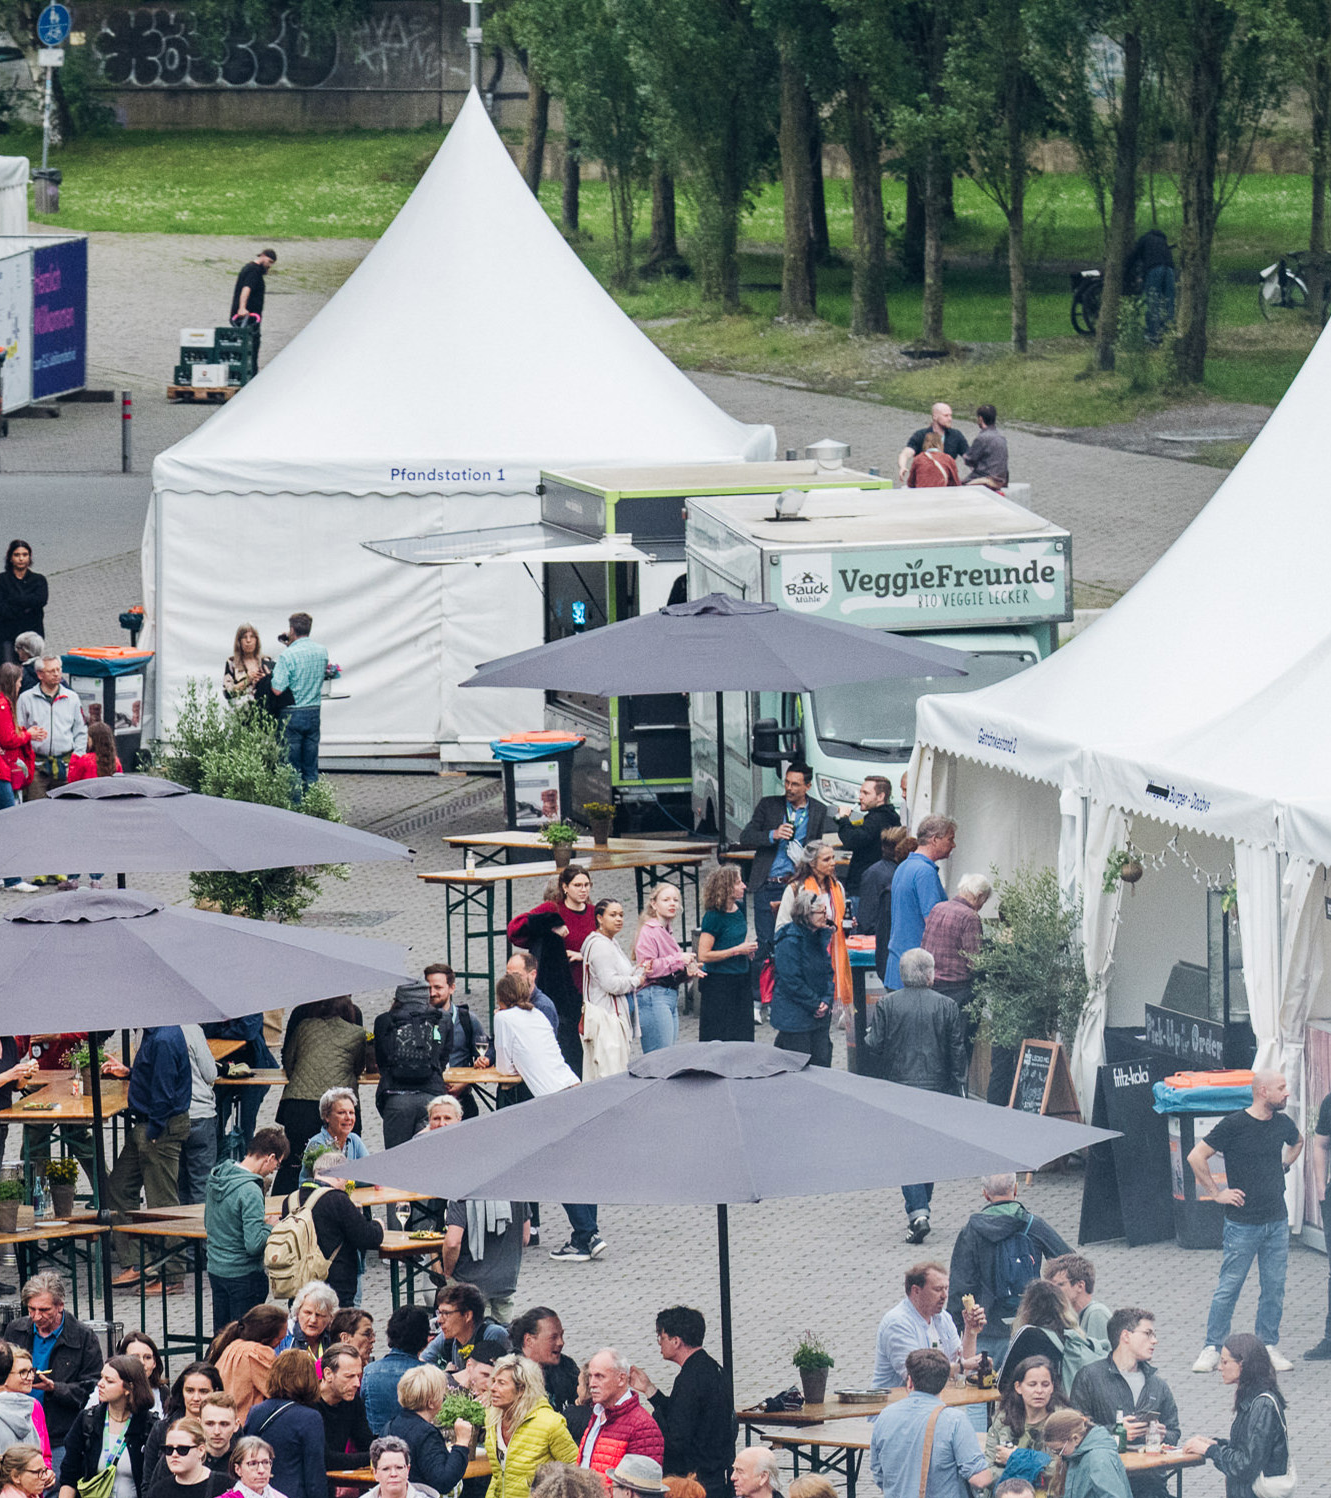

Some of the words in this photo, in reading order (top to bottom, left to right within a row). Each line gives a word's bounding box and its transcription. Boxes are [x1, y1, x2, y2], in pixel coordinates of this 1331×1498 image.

[391, 468, 491, 481] Pfandstation
[497, 468, 506, 481] 1
[839, 559, 1056, 599] VeggieFreunde
[785, 582, 828, 596] Bauck
[795, 595, 821, 604] Mühle
[918, 594, 937, 608] BIO
[942, 591, 984, 607] VEGGIE
[988, 589, 1030, 605] LECKER
[1113, 1064, 1149, 1088] fritz-kola
